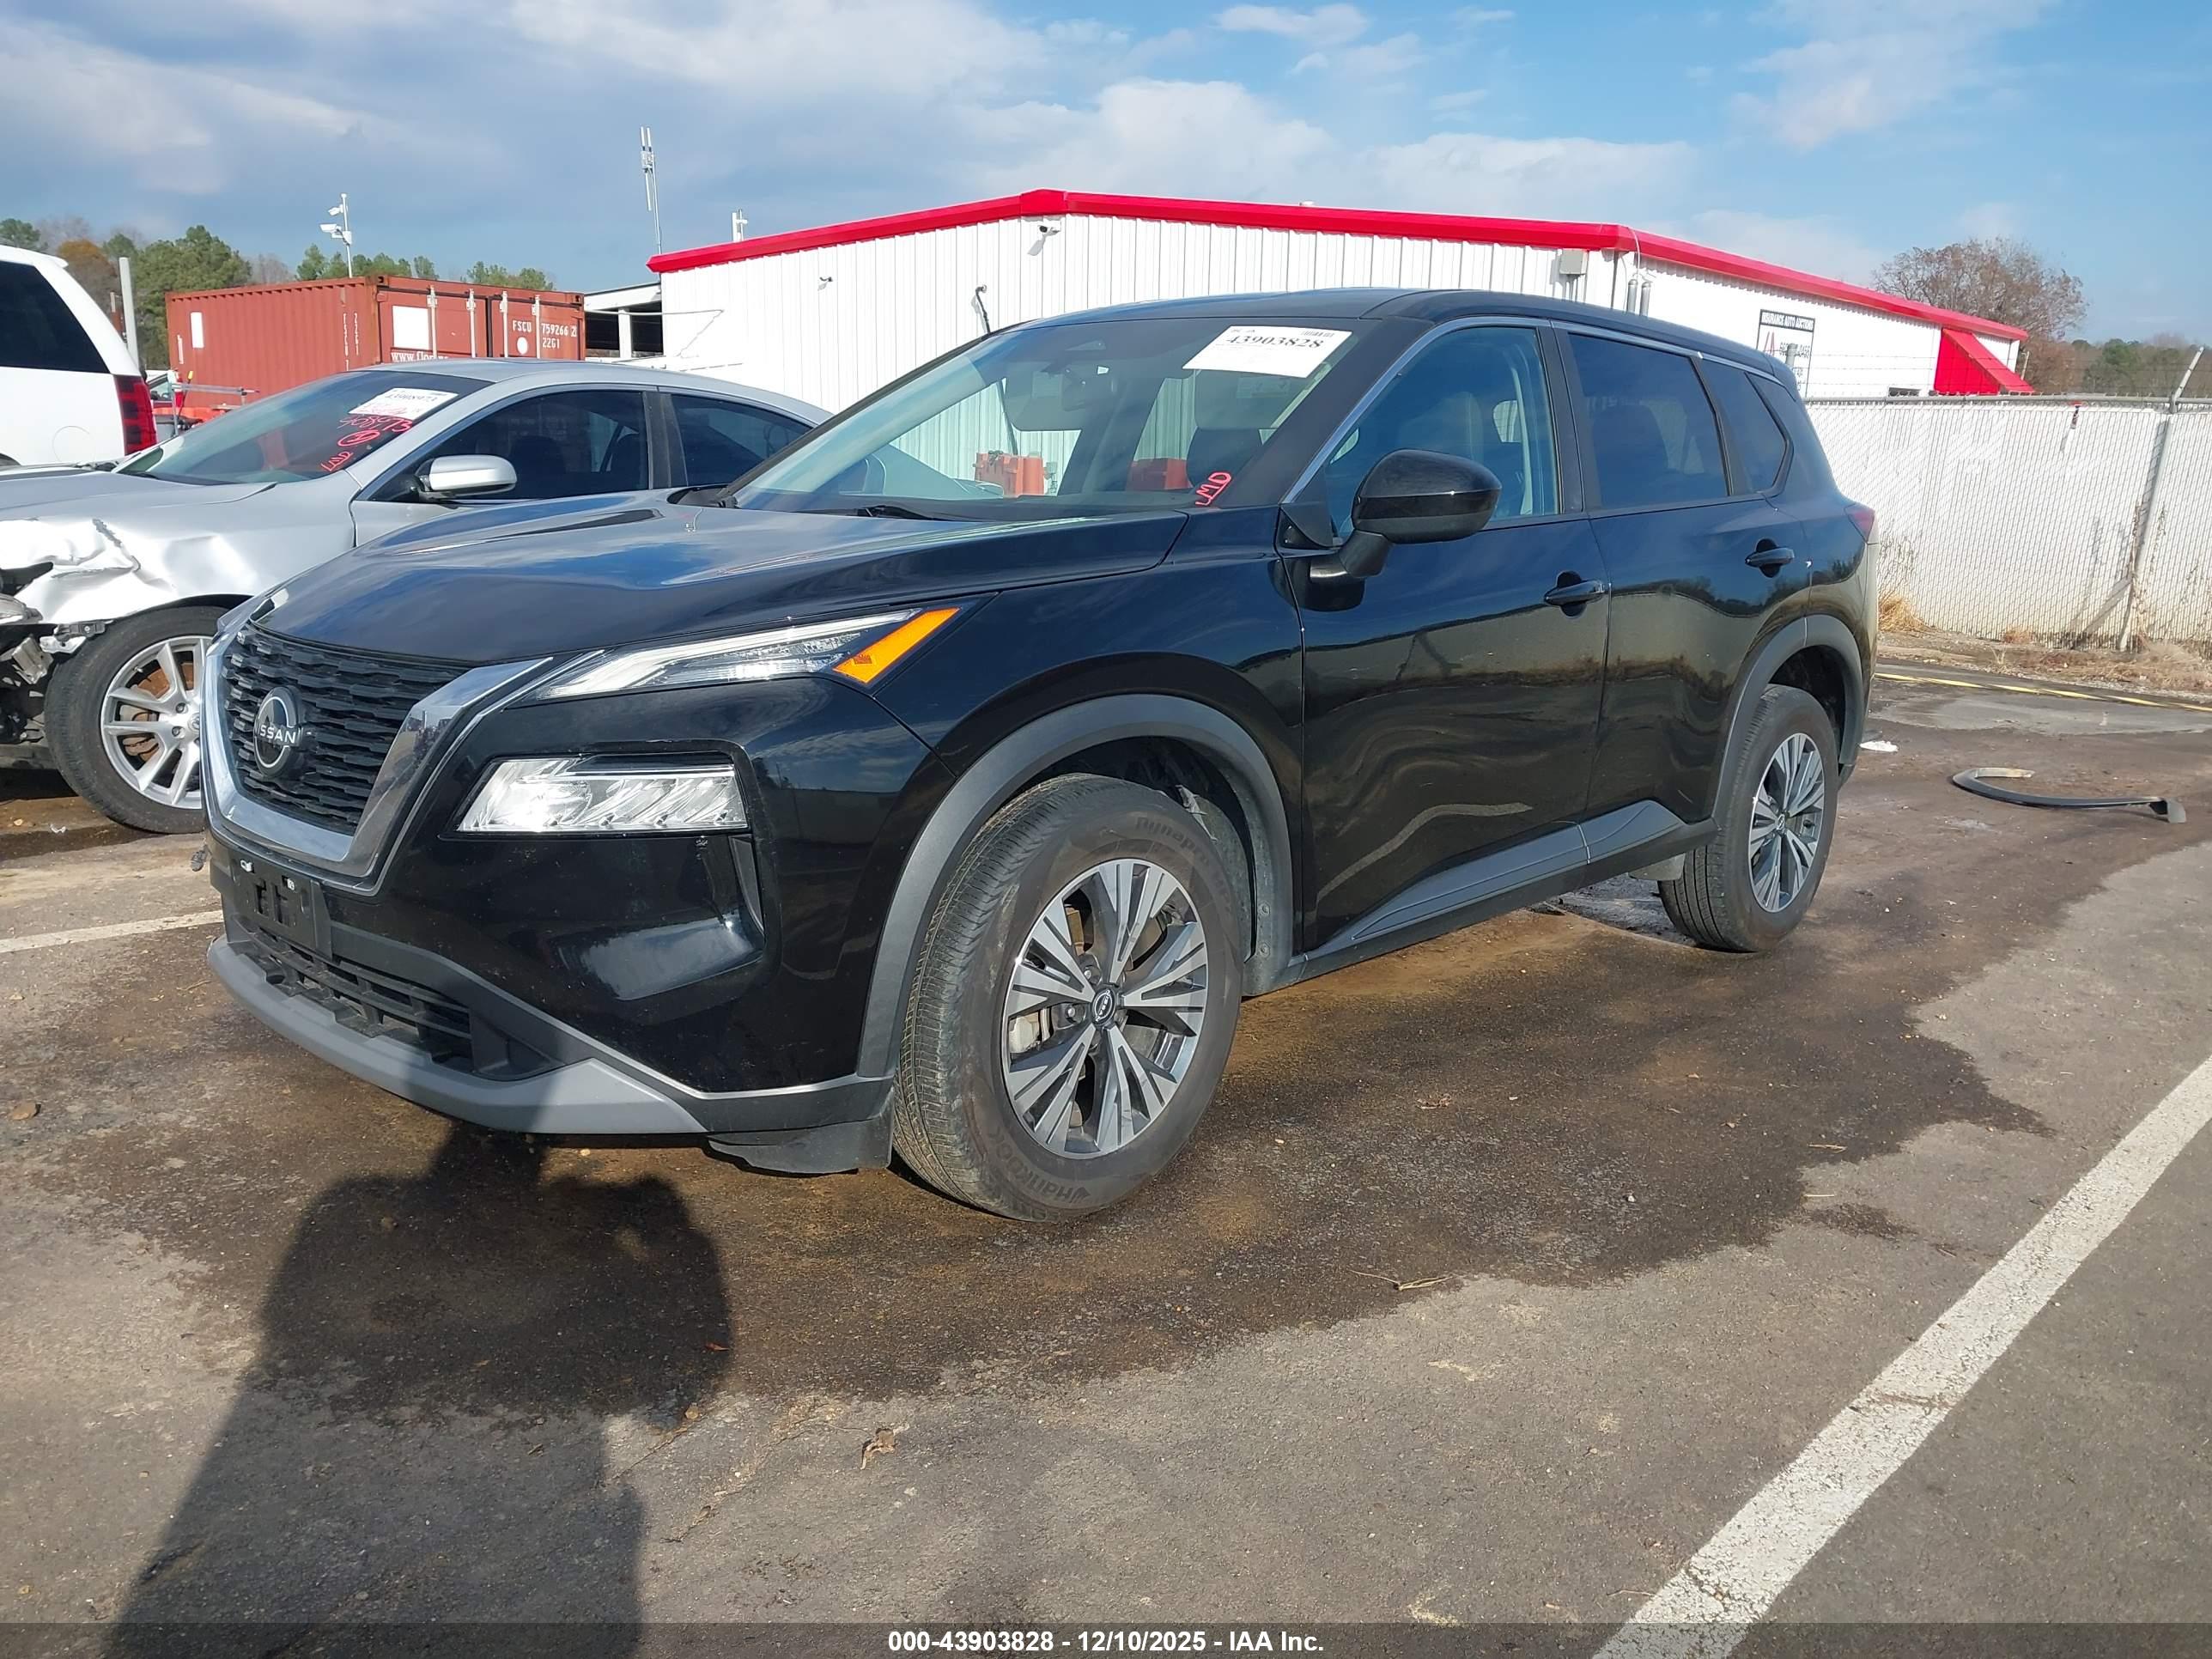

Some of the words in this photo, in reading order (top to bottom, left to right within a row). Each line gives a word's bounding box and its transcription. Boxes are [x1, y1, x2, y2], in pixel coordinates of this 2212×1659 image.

[512, 319, 532, 333] FSCU
[541, 322, 568, 337] 759266
[1226, 335, 1324, 349] 43903828
